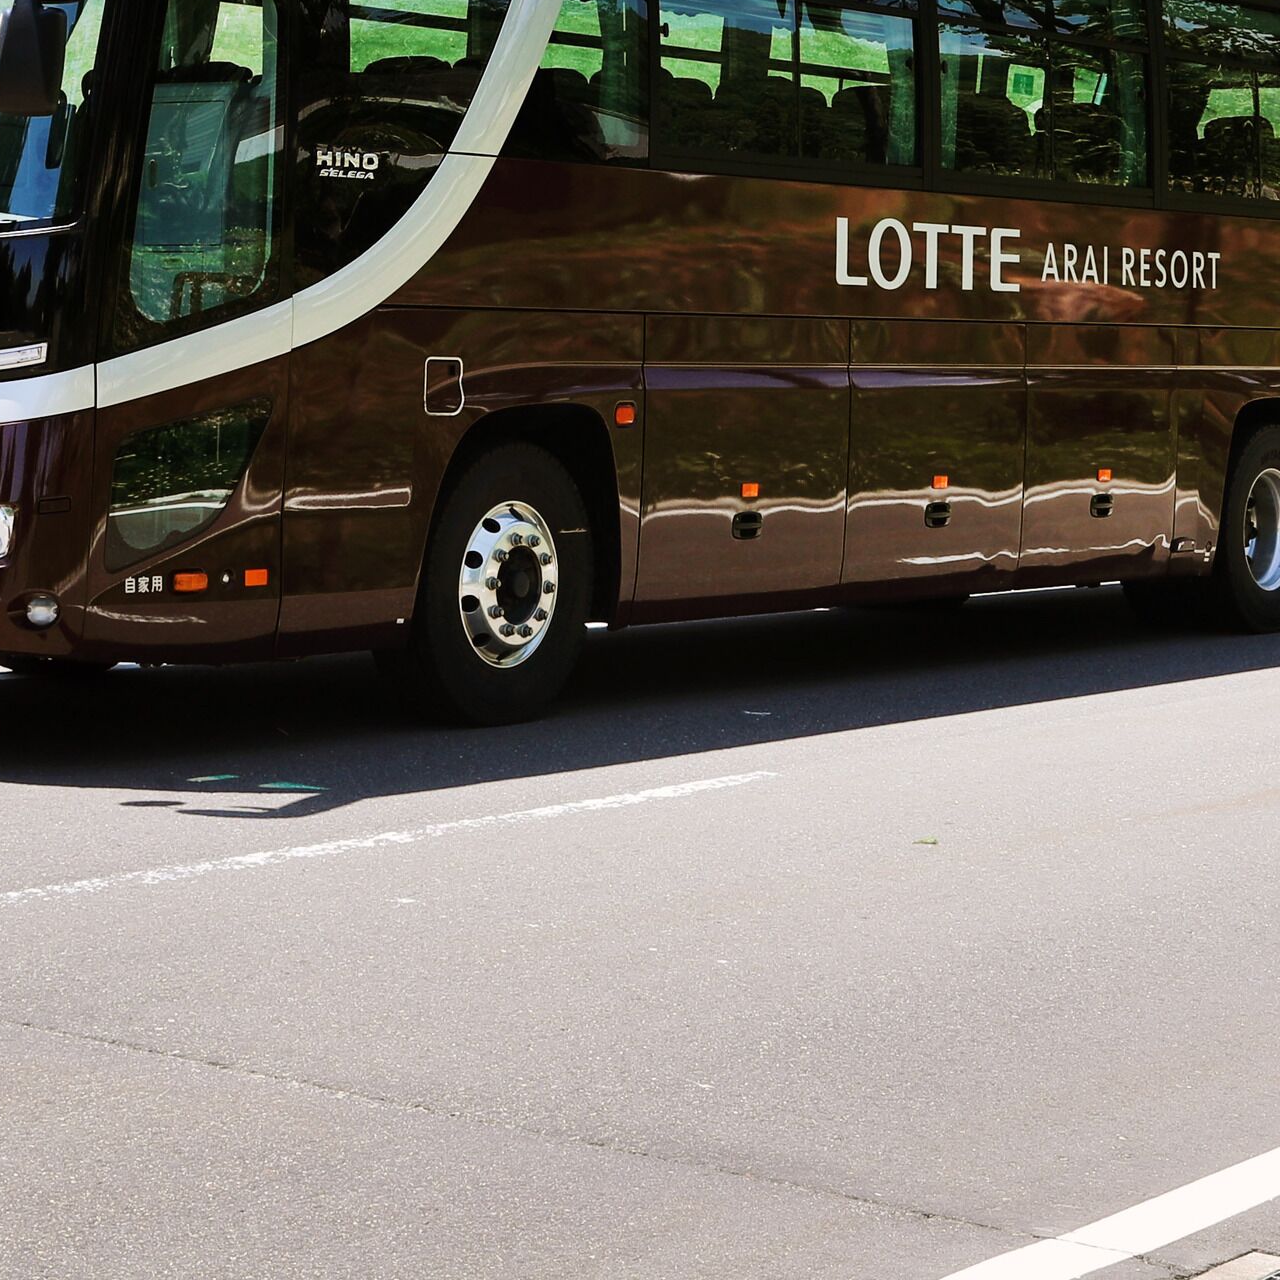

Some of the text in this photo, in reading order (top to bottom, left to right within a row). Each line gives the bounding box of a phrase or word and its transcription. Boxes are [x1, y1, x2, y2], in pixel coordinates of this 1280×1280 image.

[316, 150, 379, 171] HINO
[835, 217, 1221, 293] LOTTE ARAI RESORT
[125, 575, 163, 594] 自家用
